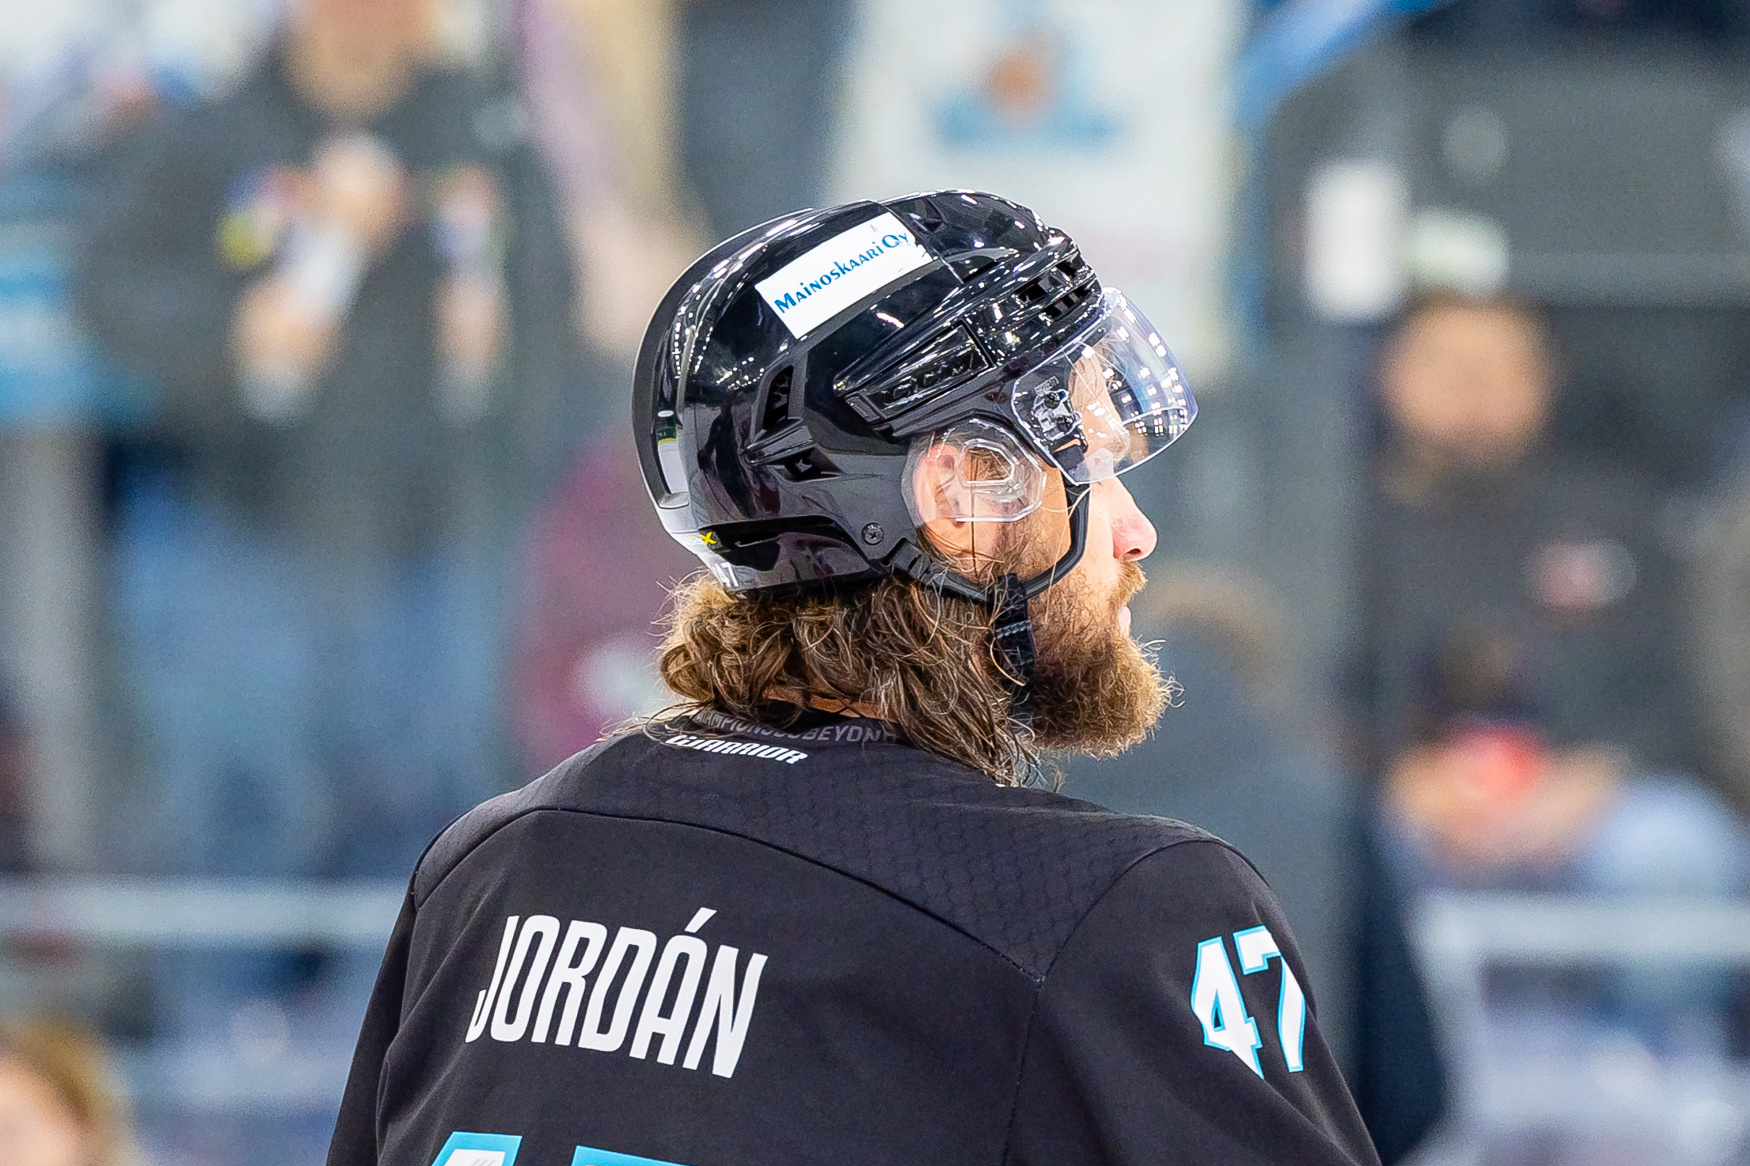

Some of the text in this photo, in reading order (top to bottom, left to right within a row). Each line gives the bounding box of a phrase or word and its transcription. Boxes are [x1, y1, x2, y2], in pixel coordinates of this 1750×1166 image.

[664, 733, 809, 765] WARRIOR
[465, 908, 768, 1079] JORDÁN
[1191, 925, 1306, 1081] 47
